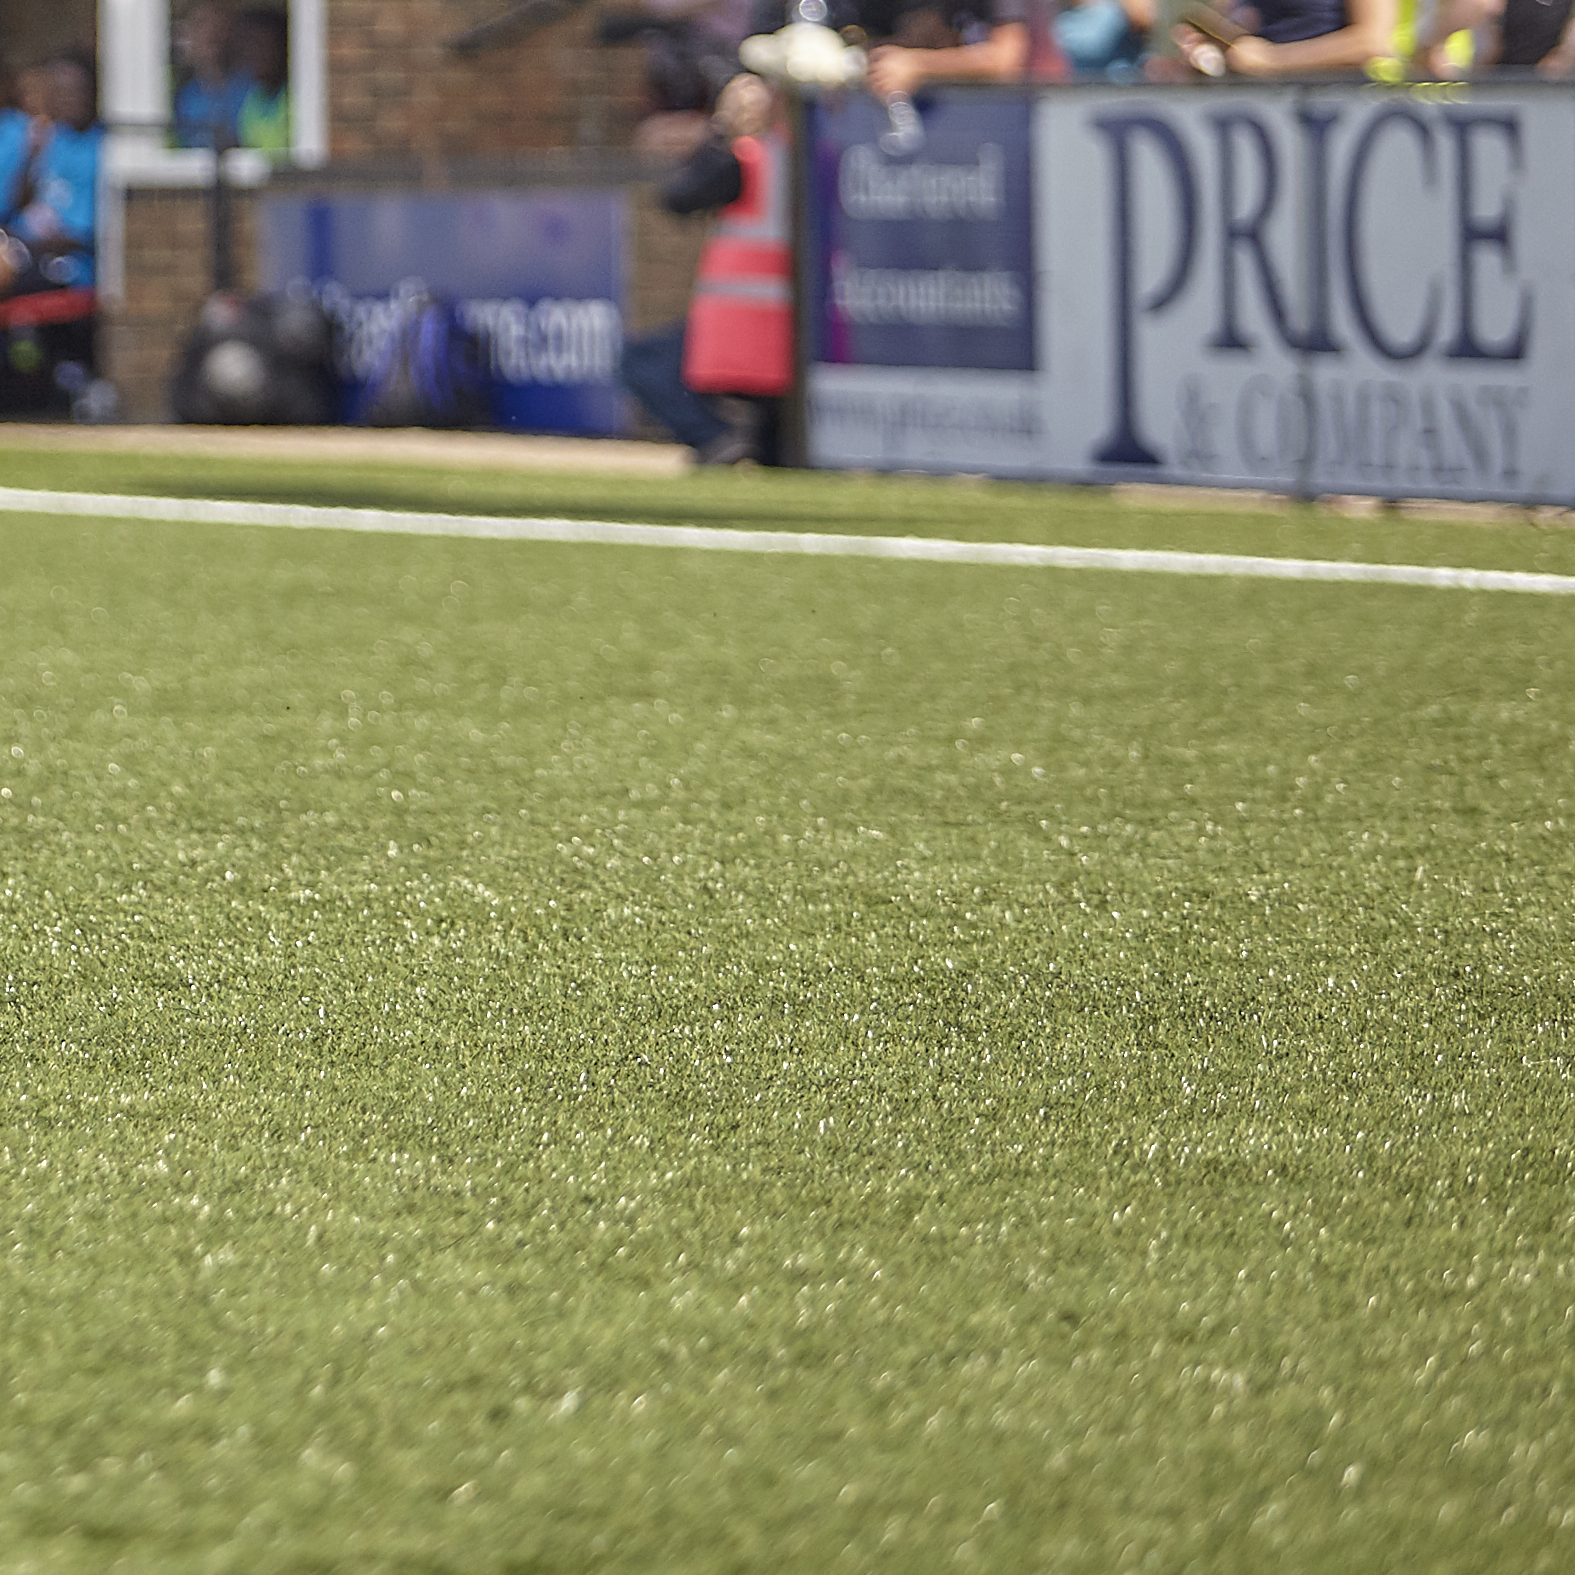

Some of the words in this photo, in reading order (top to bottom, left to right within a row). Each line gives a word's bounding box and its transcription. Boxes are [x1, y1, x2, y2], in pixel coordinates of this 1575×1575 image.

[1092, 107, 1536, 467] PRICE
[1176, 374, 1219, 460] &
[1237, 378, 1531, 480] COMPANY
